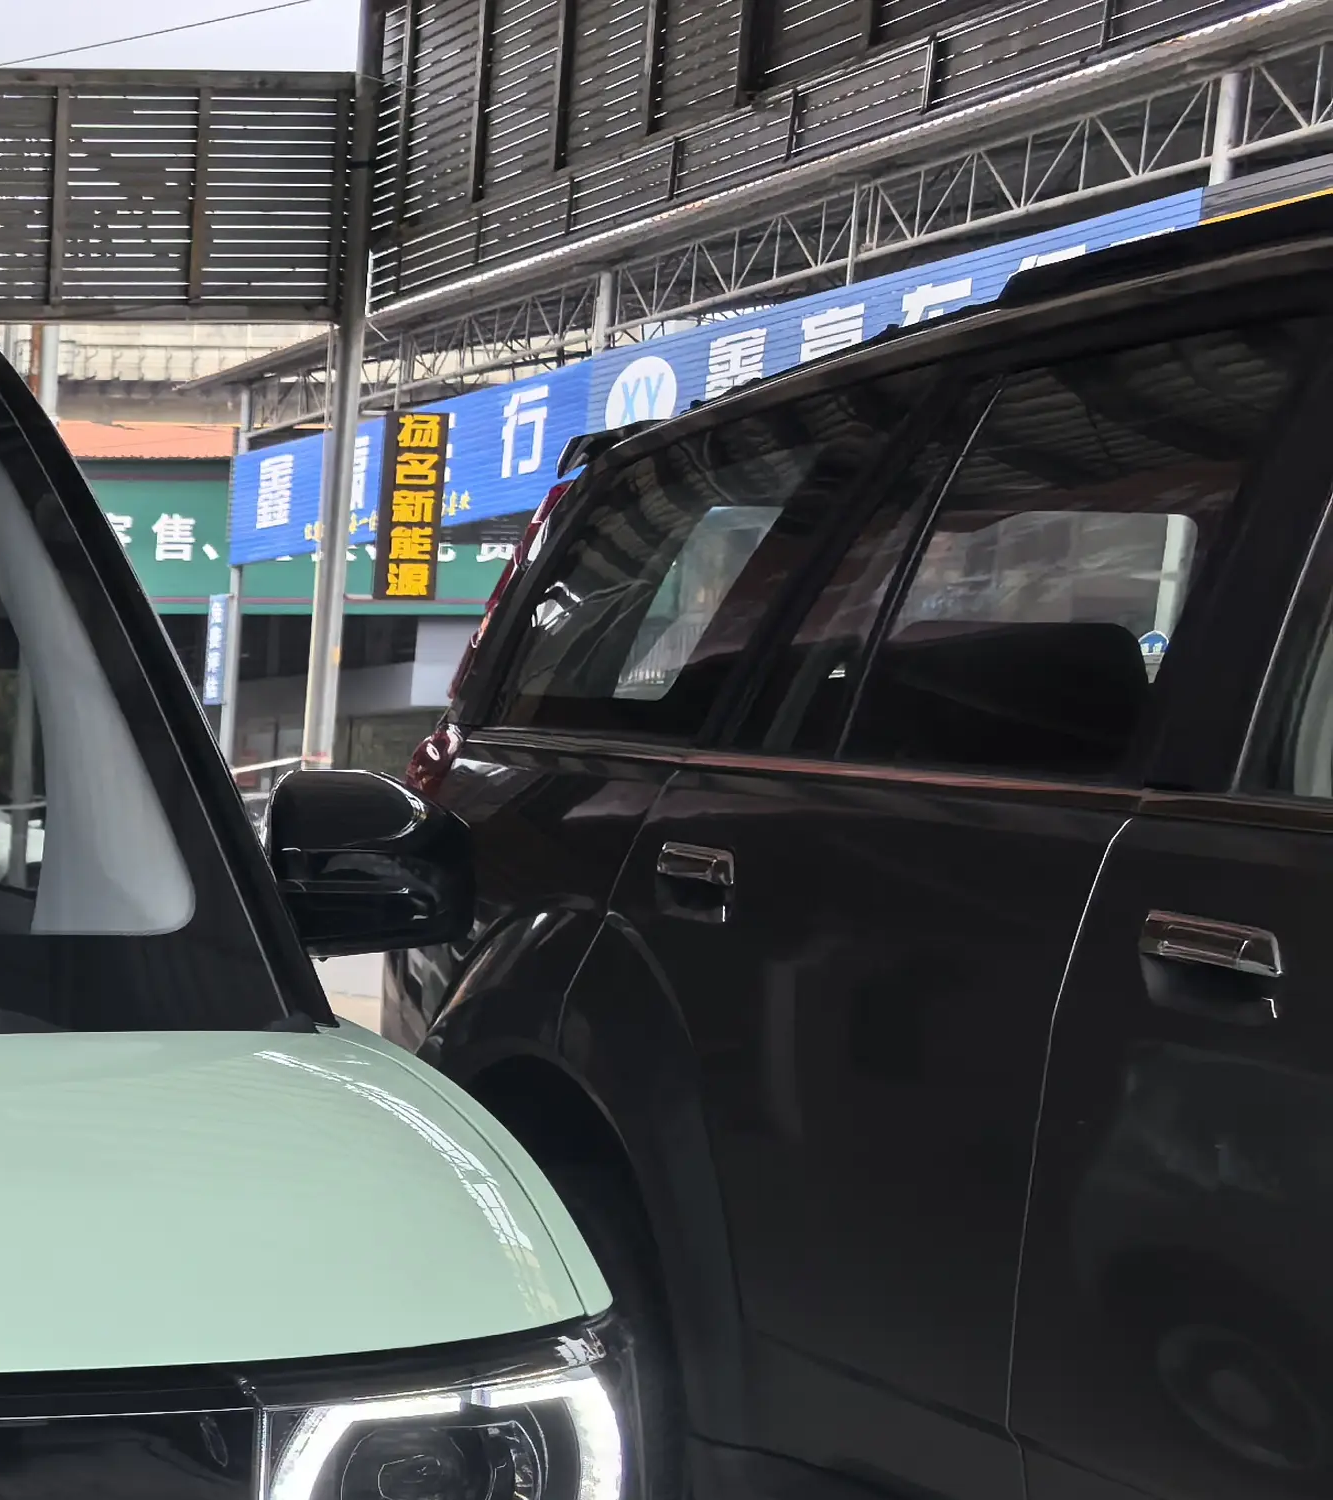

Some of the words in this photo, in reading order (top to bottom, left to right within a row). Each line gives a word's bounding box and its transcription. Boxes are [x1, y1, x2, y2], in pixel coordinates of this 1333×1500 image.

[619, 373, 665, 425] XY
[386, 414, 441, 597] 扬名新能源
